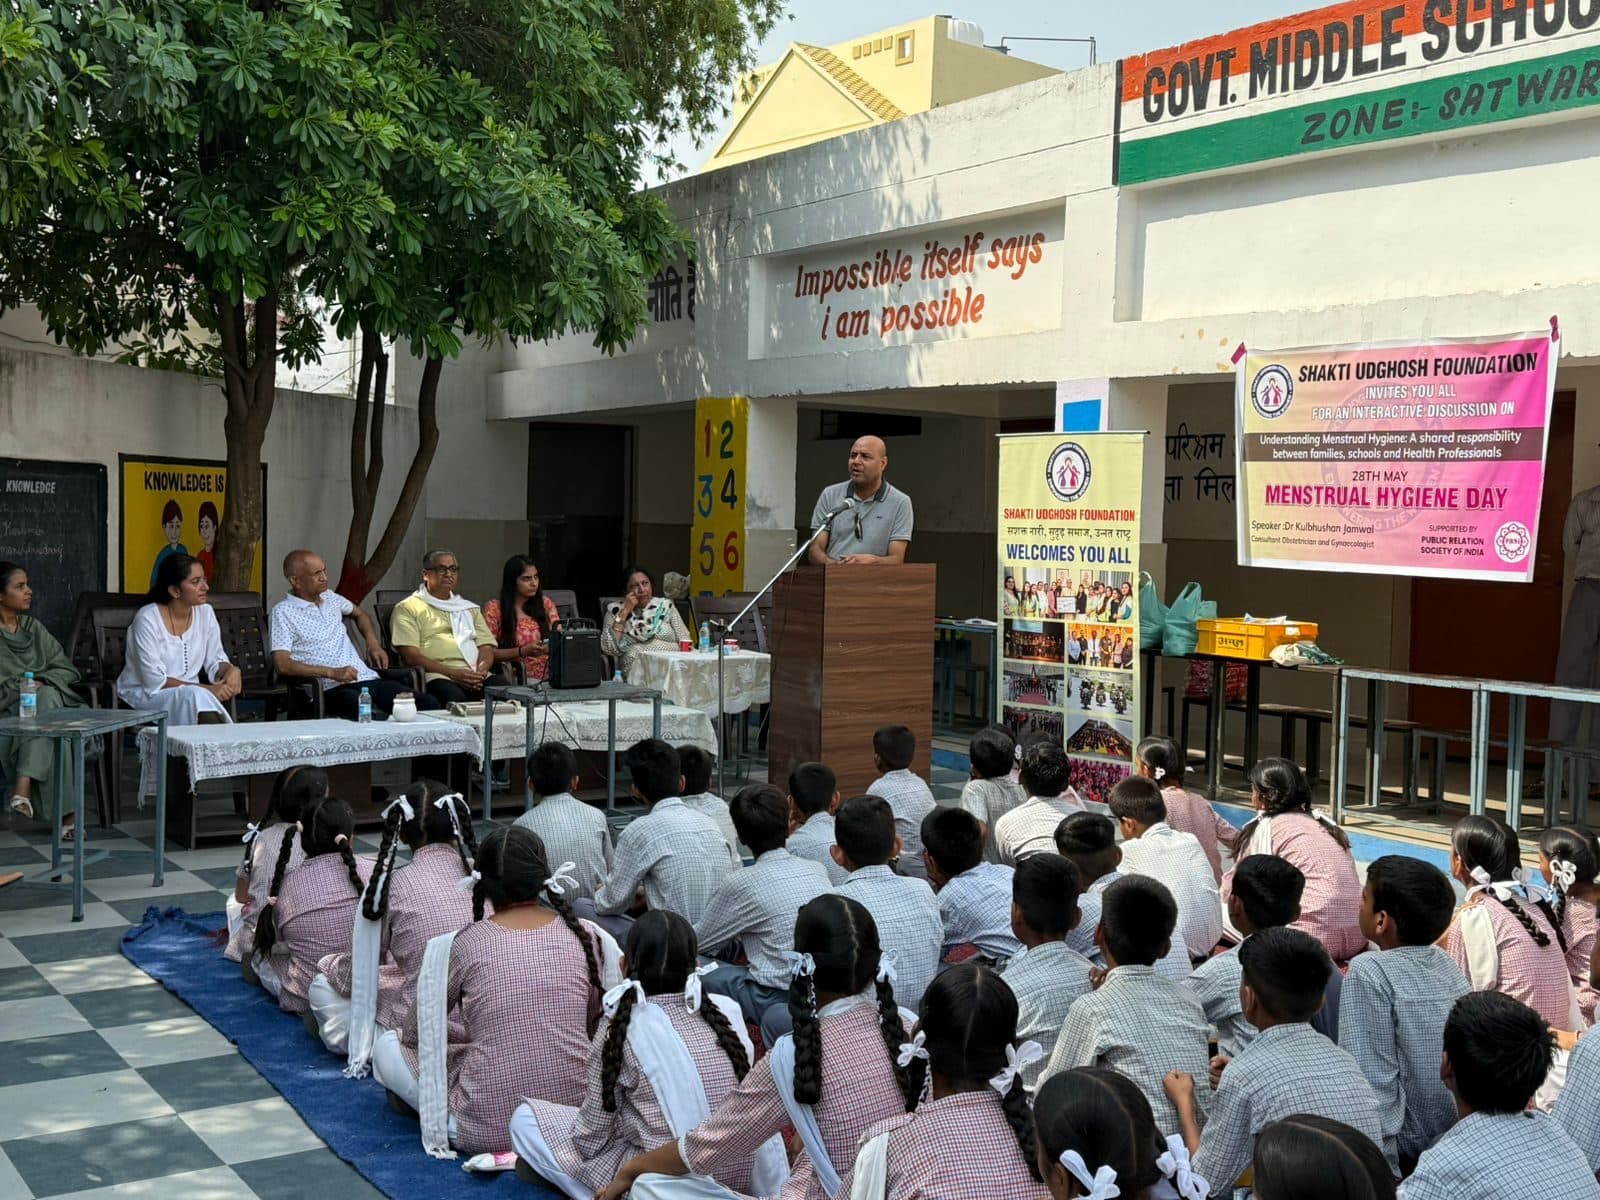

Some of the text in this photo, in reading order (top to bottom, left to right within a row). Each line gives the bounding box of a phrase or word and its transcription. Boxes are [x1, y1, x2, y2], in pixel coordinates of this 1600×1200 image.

[1143, 48, 1237, 123] GOVT.
[1248, 4, 1408, 99] MIDDLE
[794, 231, 1046, 304] Impossible itself says
[821, 286, 985, 340] i am possible
[1299, 352, 1538, 382] SHAKTI UDGHOSH FOUNDATION
[1365, 383, 1457, 400] INVITES YOU ALL
[1312, 400, 1515, 420] FOR AN INTERACTIVE DISCUSSION ON
[704, 419, 734, 459] 1 2
[1260, 430, 1521, 447] Understanding Menstrual Hygiene: A shared responsibility
[1273, 446, 1502, 460] between families, schools and Health Professionals
[144, 471, 224, 492] KNOWLEDGE IS
[1352, 470, 1408, 482] 28TH MAY
[6, 480, 56, 494] KNOWLEDGE
[697, 468, 738, 518] 3 4
[1265, 484, 1508, 508] MENSTRUAL HYGIENE DAY
[1003, 508, 1135, 521] SHAKTI UDGHOSH FOUNDATION
[1251, 520, 1281, 531] Speaker
[1295, 522, 1341, 533] Kulbhushan
[1343, 524, 1375, 535] Jamwal
[1469, 525, 1478, 533] BY
[1251, 535, 1281, 543] Consultant
[1282, 536, 1317, 546] Obstetrician
[1331, 538, 1375, 549] Gynaecologist
[1421, 535, 1485, 546] PUBLIC RELATION
[699, 531, 739, 576] 5 6
[1006, 543, 1131, 564] WELCOMES YOU ALL
[1420, 546, 1485, 556] SOCIETY OF INDIA
